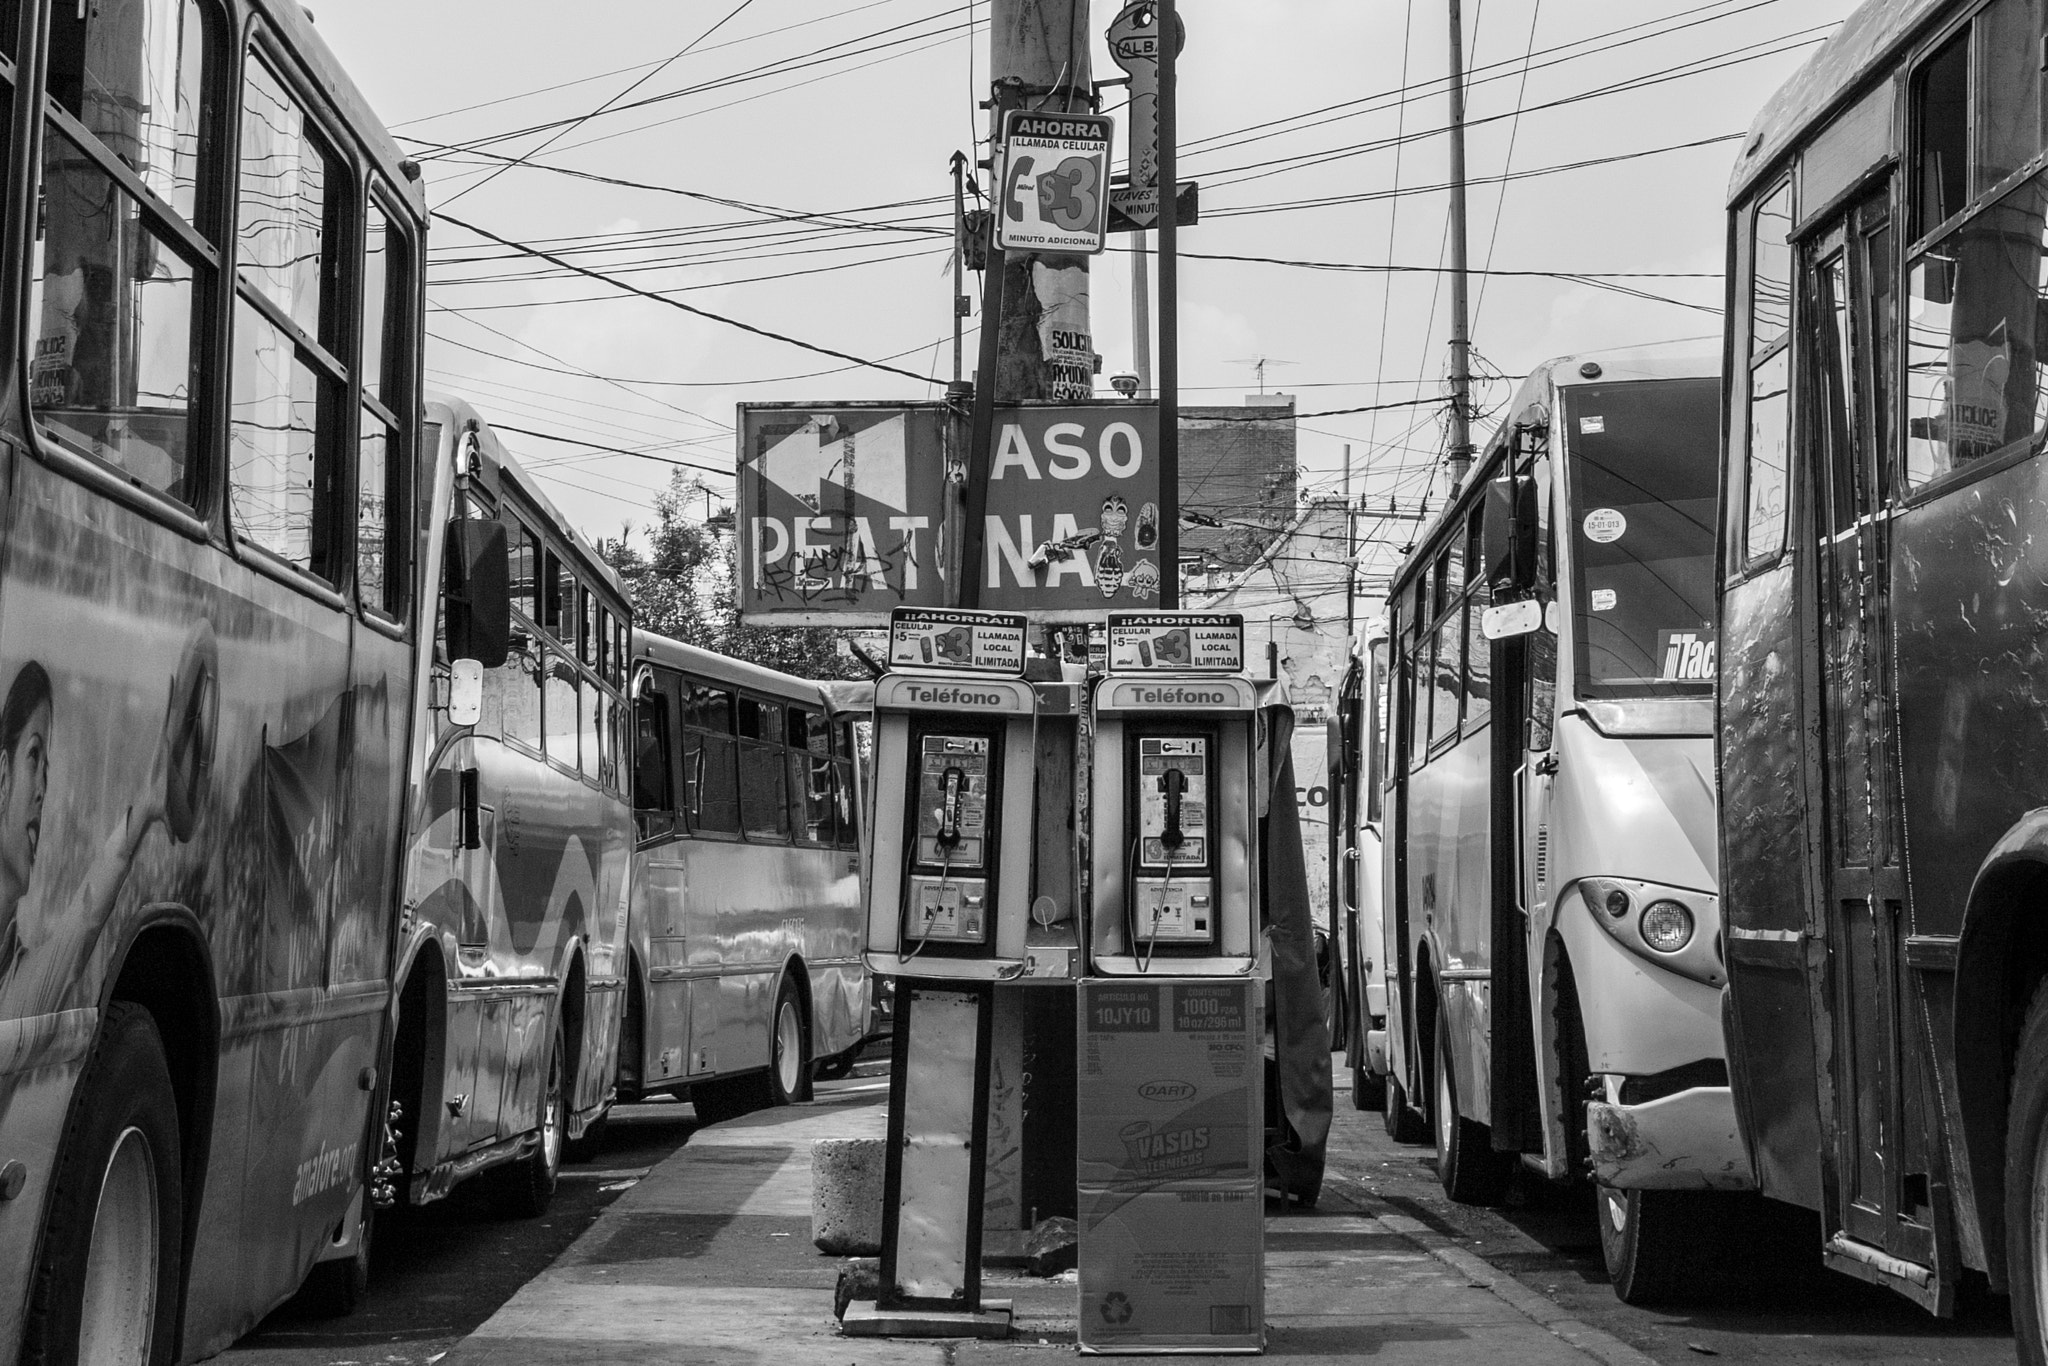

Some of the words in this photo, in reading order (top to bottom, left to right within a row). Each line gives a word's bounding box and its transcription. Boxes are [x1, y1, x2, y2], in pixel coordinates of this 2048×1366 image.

[1017, 119, 1102, 138] AHORRA
[1062, 140, 1106, 152] CELULAR
[1112, 190, 1153, 203] LLAVES
[1008, 233, 1046, 244] MINUTO
[1047, 236, 1098, 246] ADICIONAL
[895, 622, 934, 631] CELULAR
[895, 631, 908, 642] $5
[977, 631, 1020, 641] LLAMADA
[1113, 637, 1125, 647] $5
[1195, 632, 1238, 640] LLAMADA
[983, 643, 1013, 652] LOCAL
[975, 656, 1020, 668] ILIMITADA
[1194, 657, 1239, 667] ILIMITADA
[906, 686, 1001, 705] Teléfono
[1130, 687, 1225, 704] Teléfono
[1181, 998, 1219, 1015] 1000
[1096, 1007, 1151, 1025] 10JY10
[1178, 1017, 1190, 1028] 10
[1191, 1017, 1227, 1029] oz/296
[1228, 1017, 1241, 1028] ml
[1144, 1085, 1190, 1096] DART
[1137, 1127, 1210, 1160] VASOS
[292, 1139, 357, 1207] amafore.org
